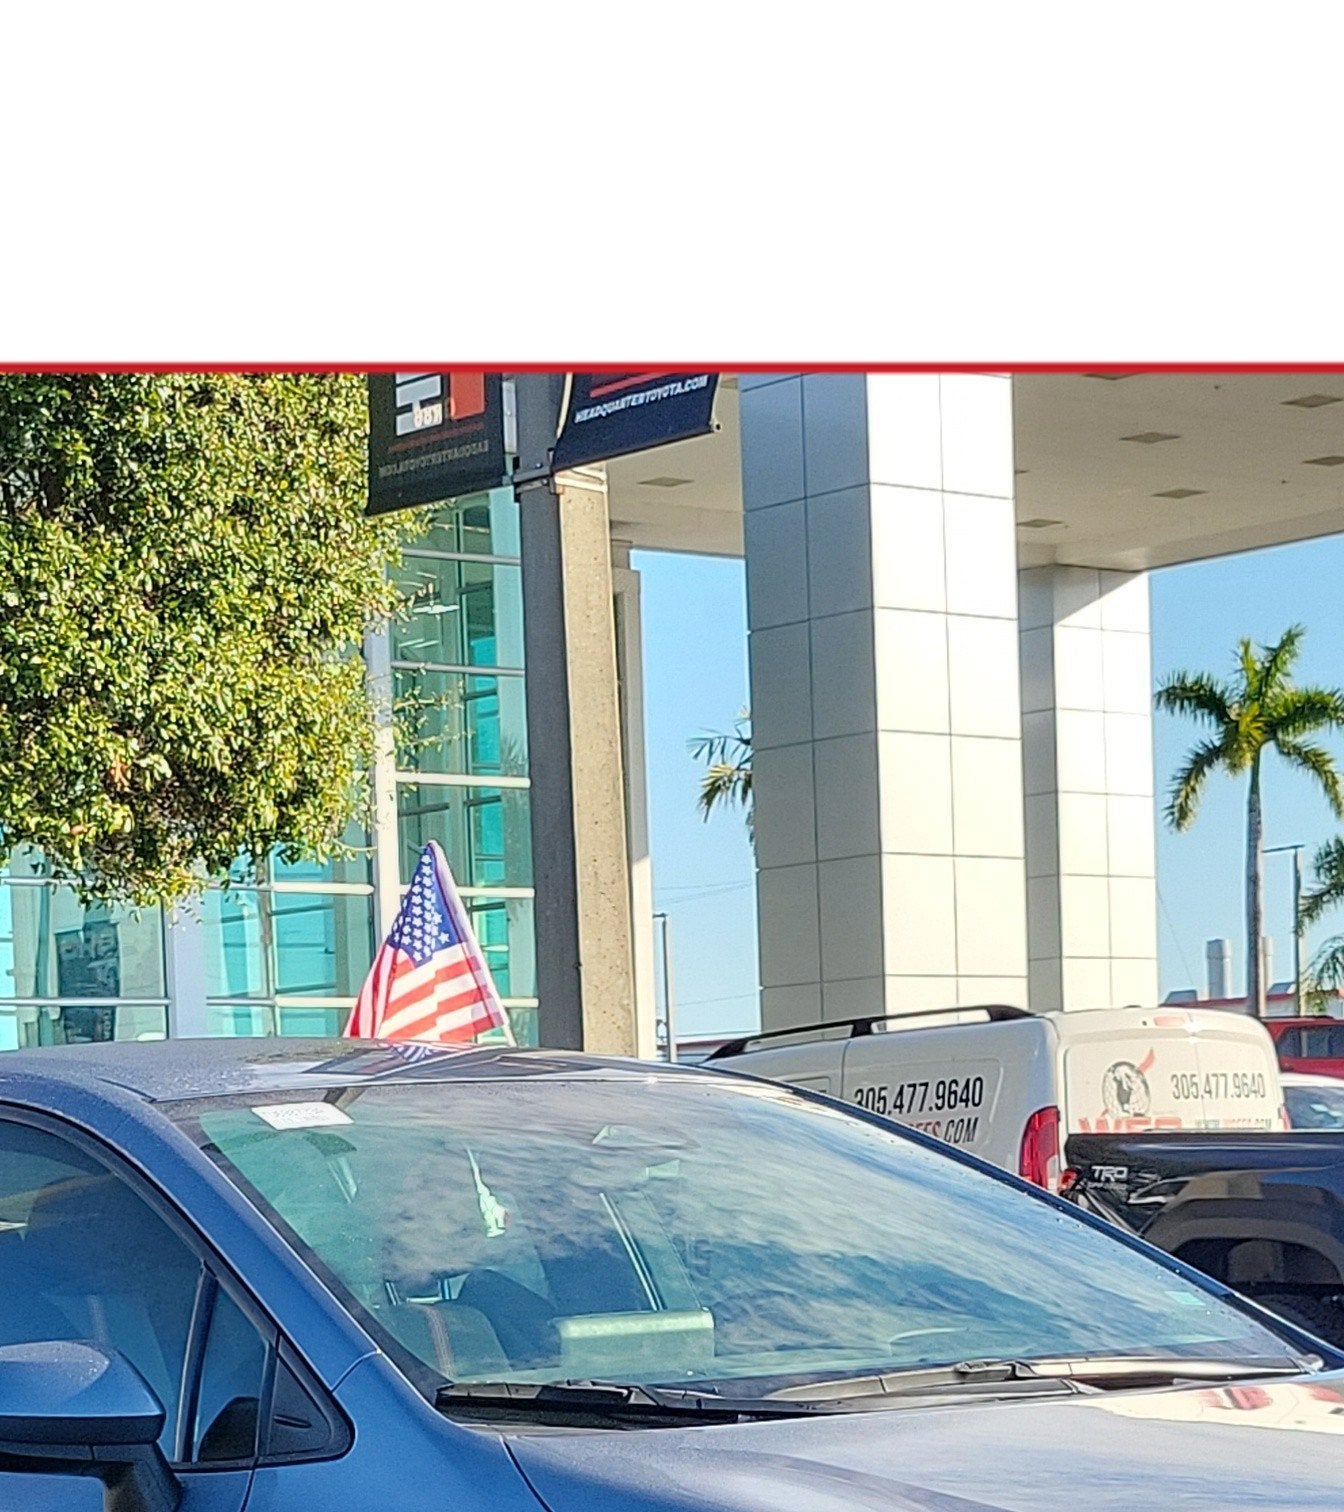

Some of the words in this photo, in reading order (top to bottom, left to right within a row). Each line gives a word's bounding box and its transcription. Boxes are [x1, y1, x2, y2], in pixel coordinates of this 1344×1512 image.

[574, 374, 709, 423] HEADQUARTERTOYOTA.COM
[855, 1076, 984, 1116] 305.477.9640
[1170, 1072, 1267, 1100] 305.477.9640
